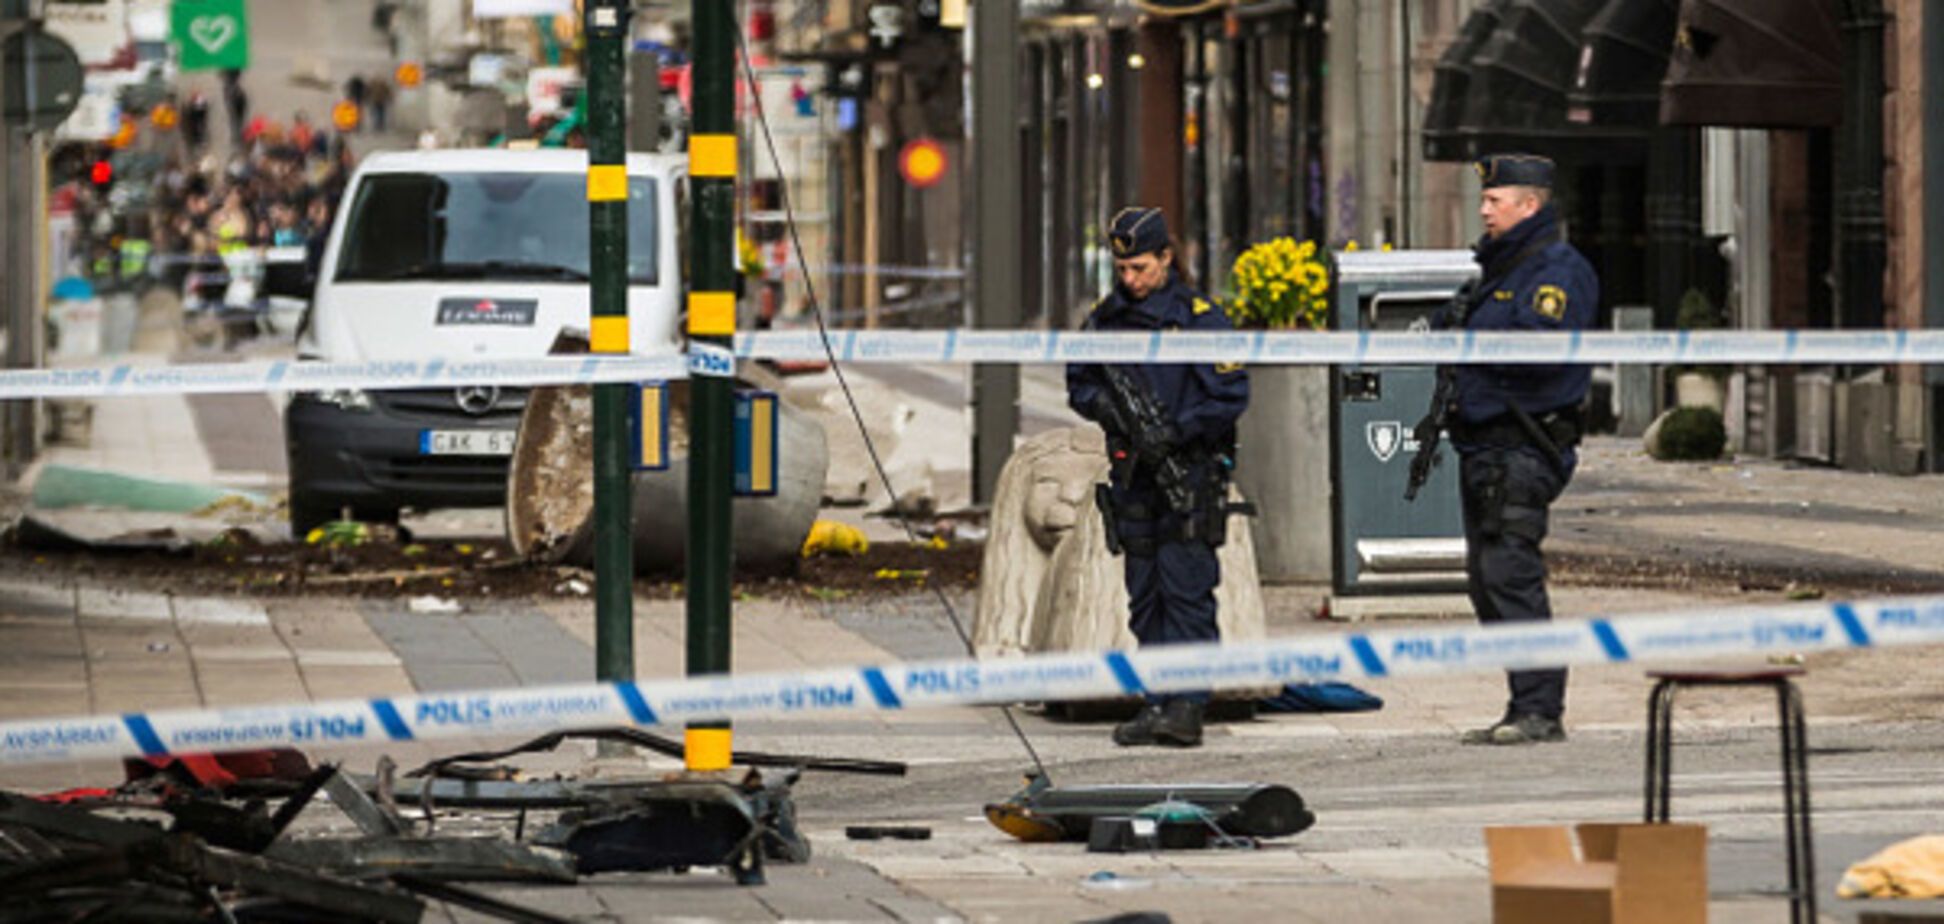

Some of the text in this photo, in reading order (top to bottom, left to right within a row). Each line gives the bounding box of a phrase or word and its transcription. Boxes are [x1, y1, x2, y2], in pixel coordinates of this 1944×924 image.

[905, 666, 980, 693] POLIS
[778, 685, 853, 708] POLIS
[415, 699, 491, 725] POLIS
[289, 715, 364, 741] POLIS
